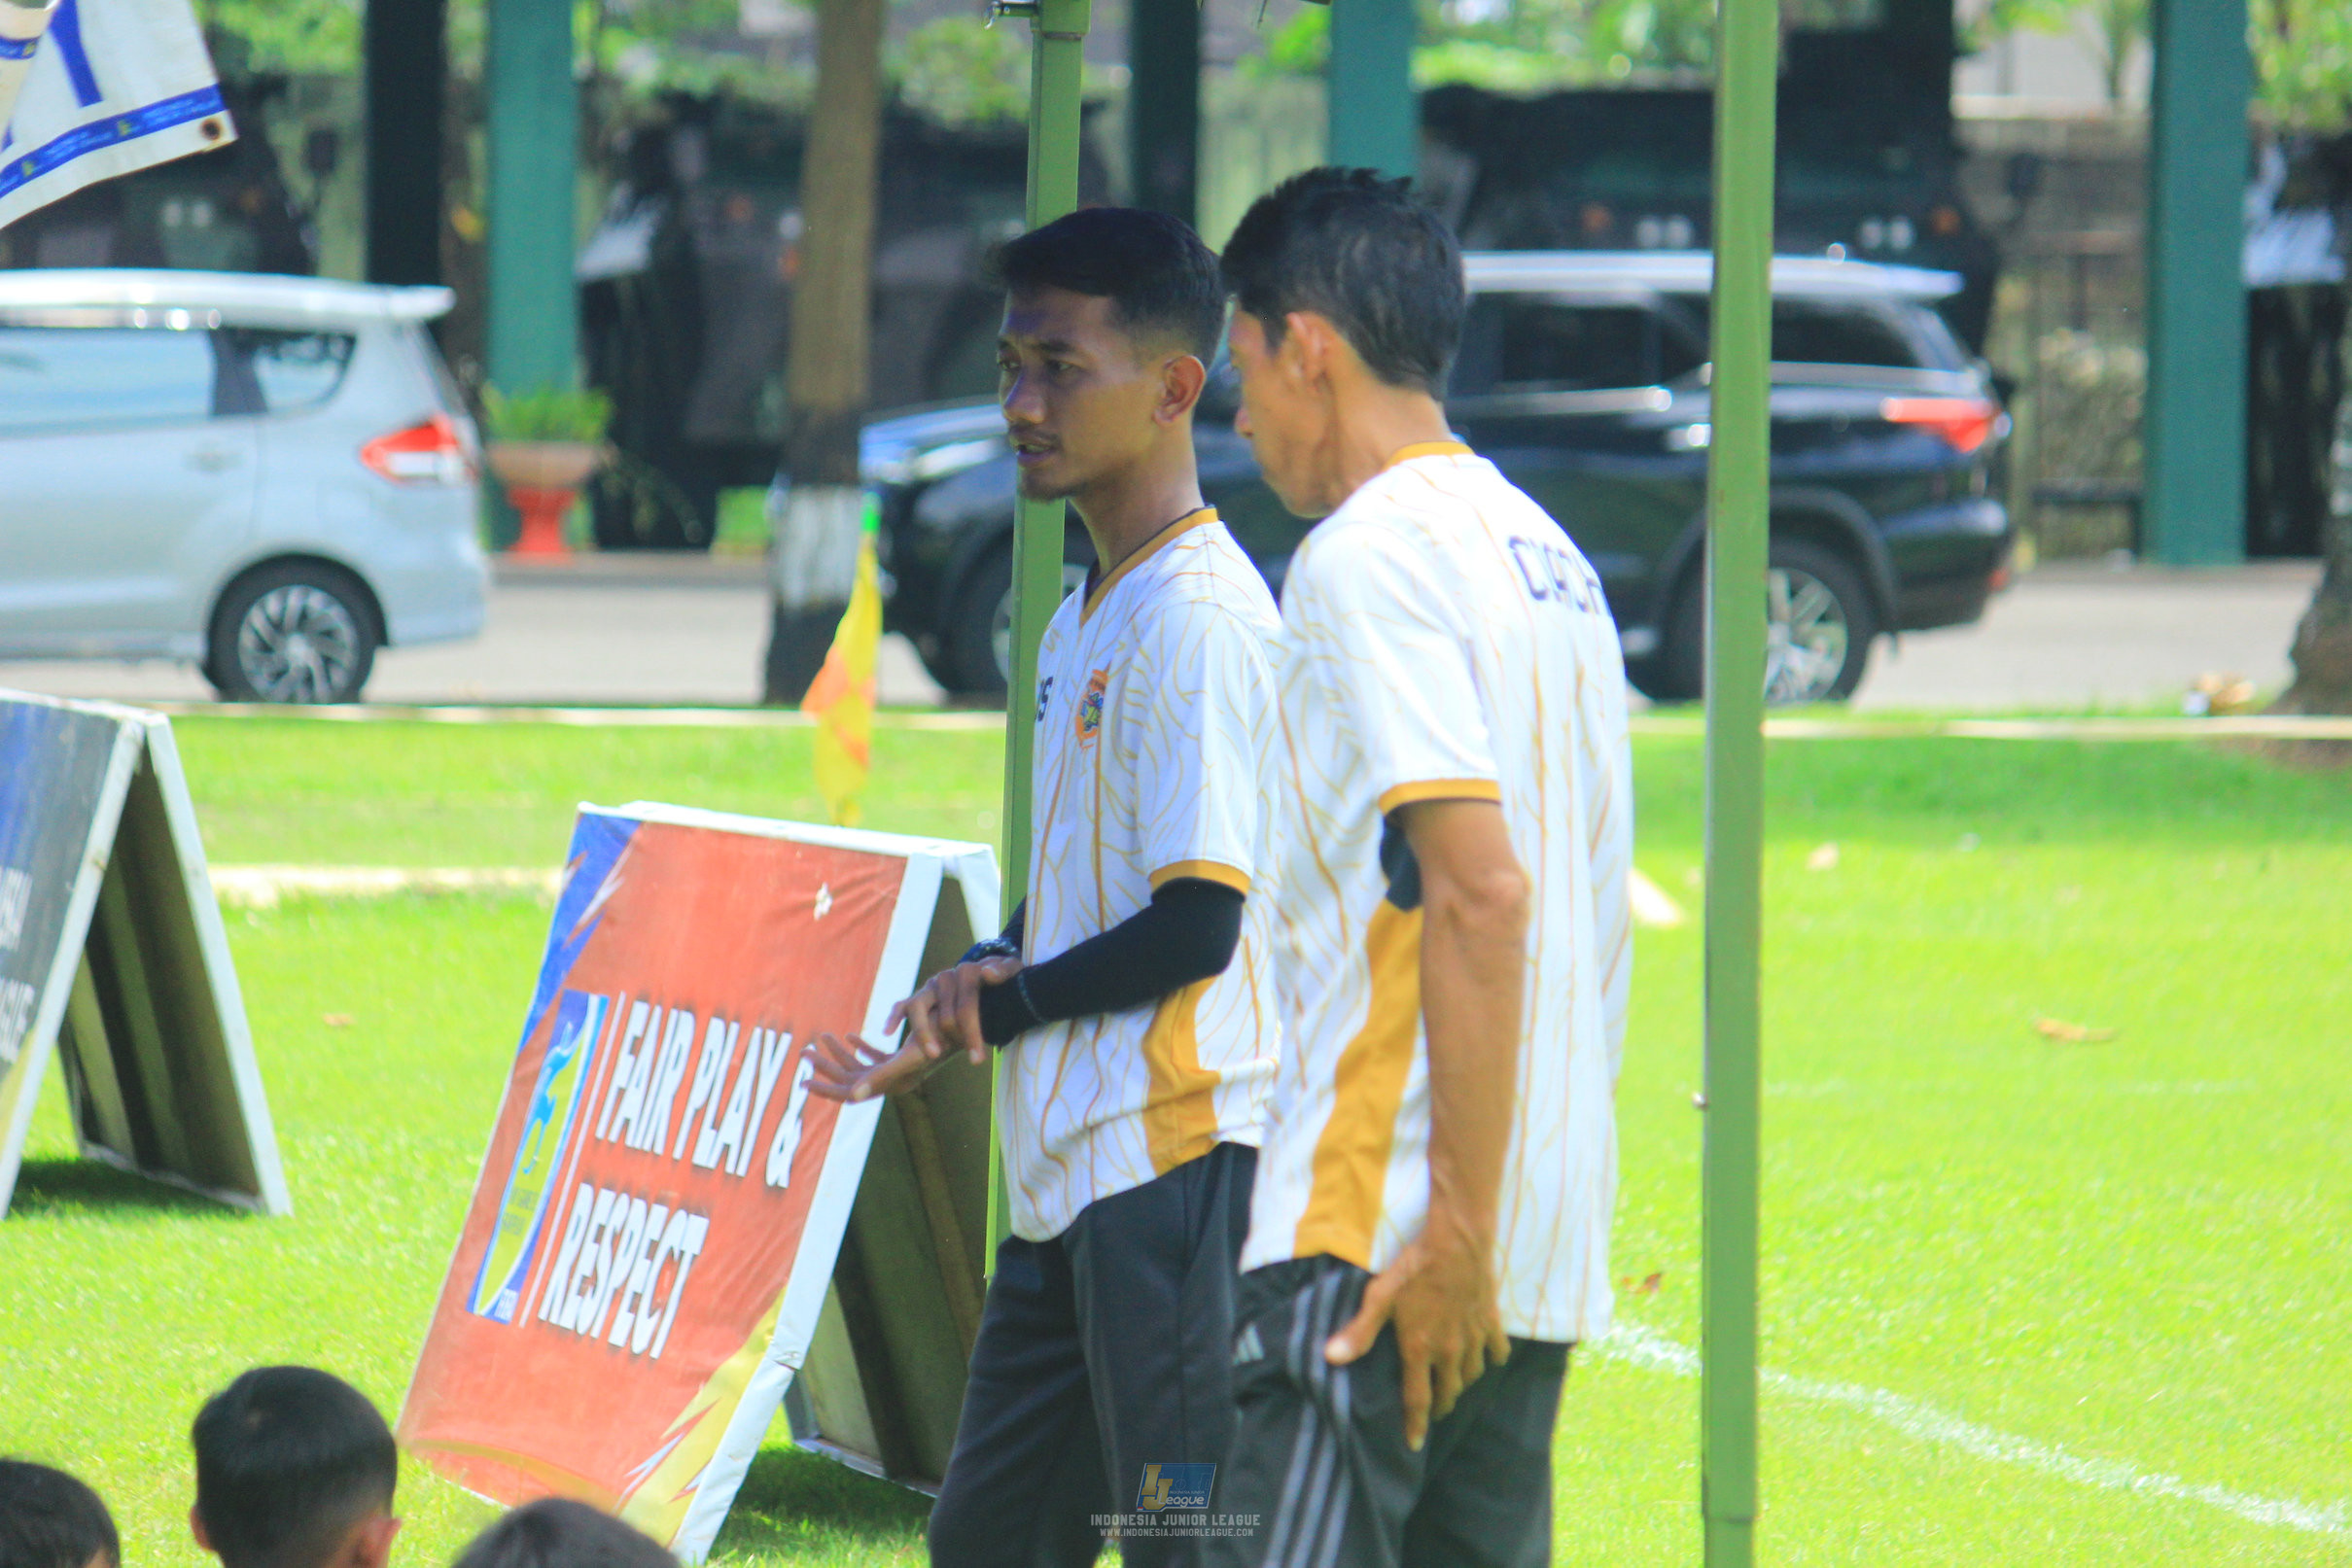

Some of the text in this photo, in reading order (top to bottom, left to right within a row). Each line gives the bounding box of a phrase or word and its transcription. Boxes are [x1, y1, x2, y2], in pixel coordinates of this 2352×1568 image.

[595, 999, 817, 1189] FAIR PLAY &
[538, 1182, 710, 1360] RESPECT
